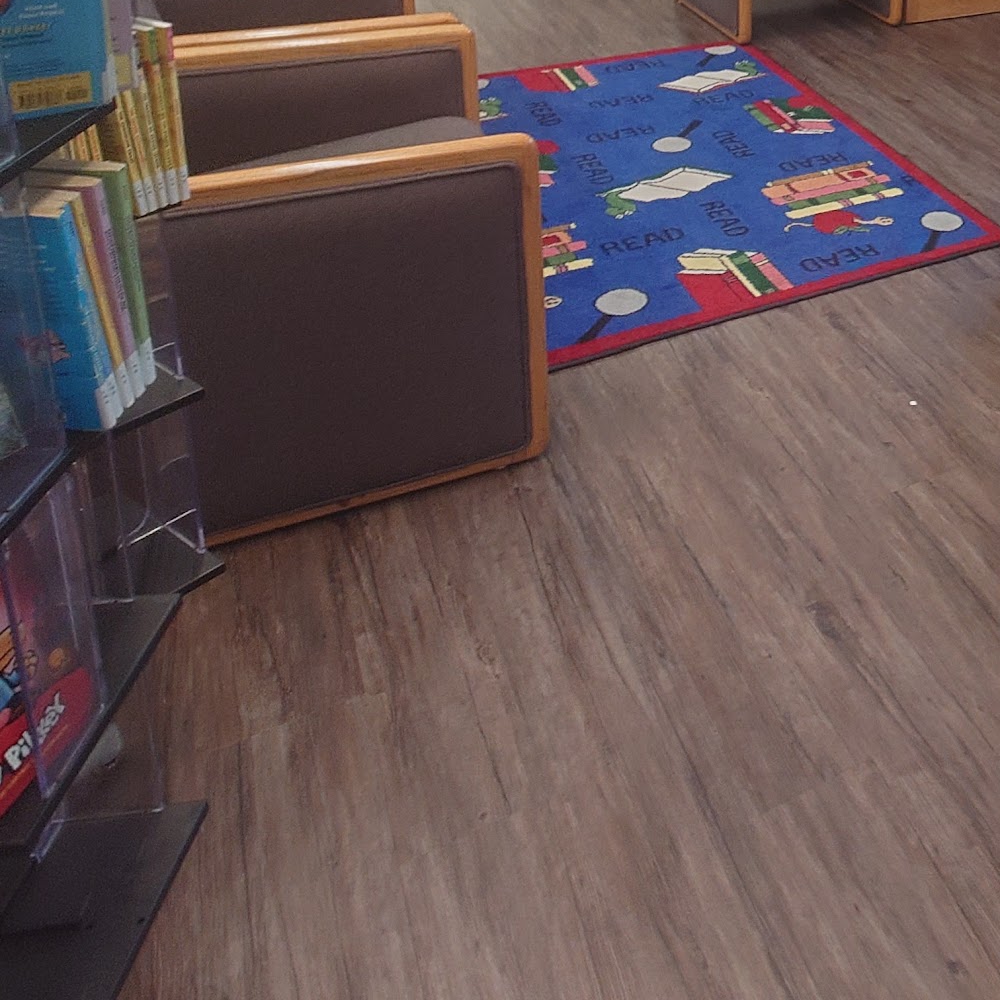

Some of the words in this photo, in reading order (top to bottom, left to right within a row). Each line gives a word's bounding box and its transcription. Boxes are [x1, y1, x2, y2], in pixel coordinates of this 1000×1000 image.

[525, 101, 563, 128] READ
[586, 125, 656, 144] READ
[712, 129, 756, 160] READ
[571, 151, 615, 186] READ
[778, 151, 848, 172] READ
[700, 200, 749, 238] READ
[601, 226, 686, 258] READ
[800, 243, 881, 273] READ
[4, 691, 65, 771] Pilkey
